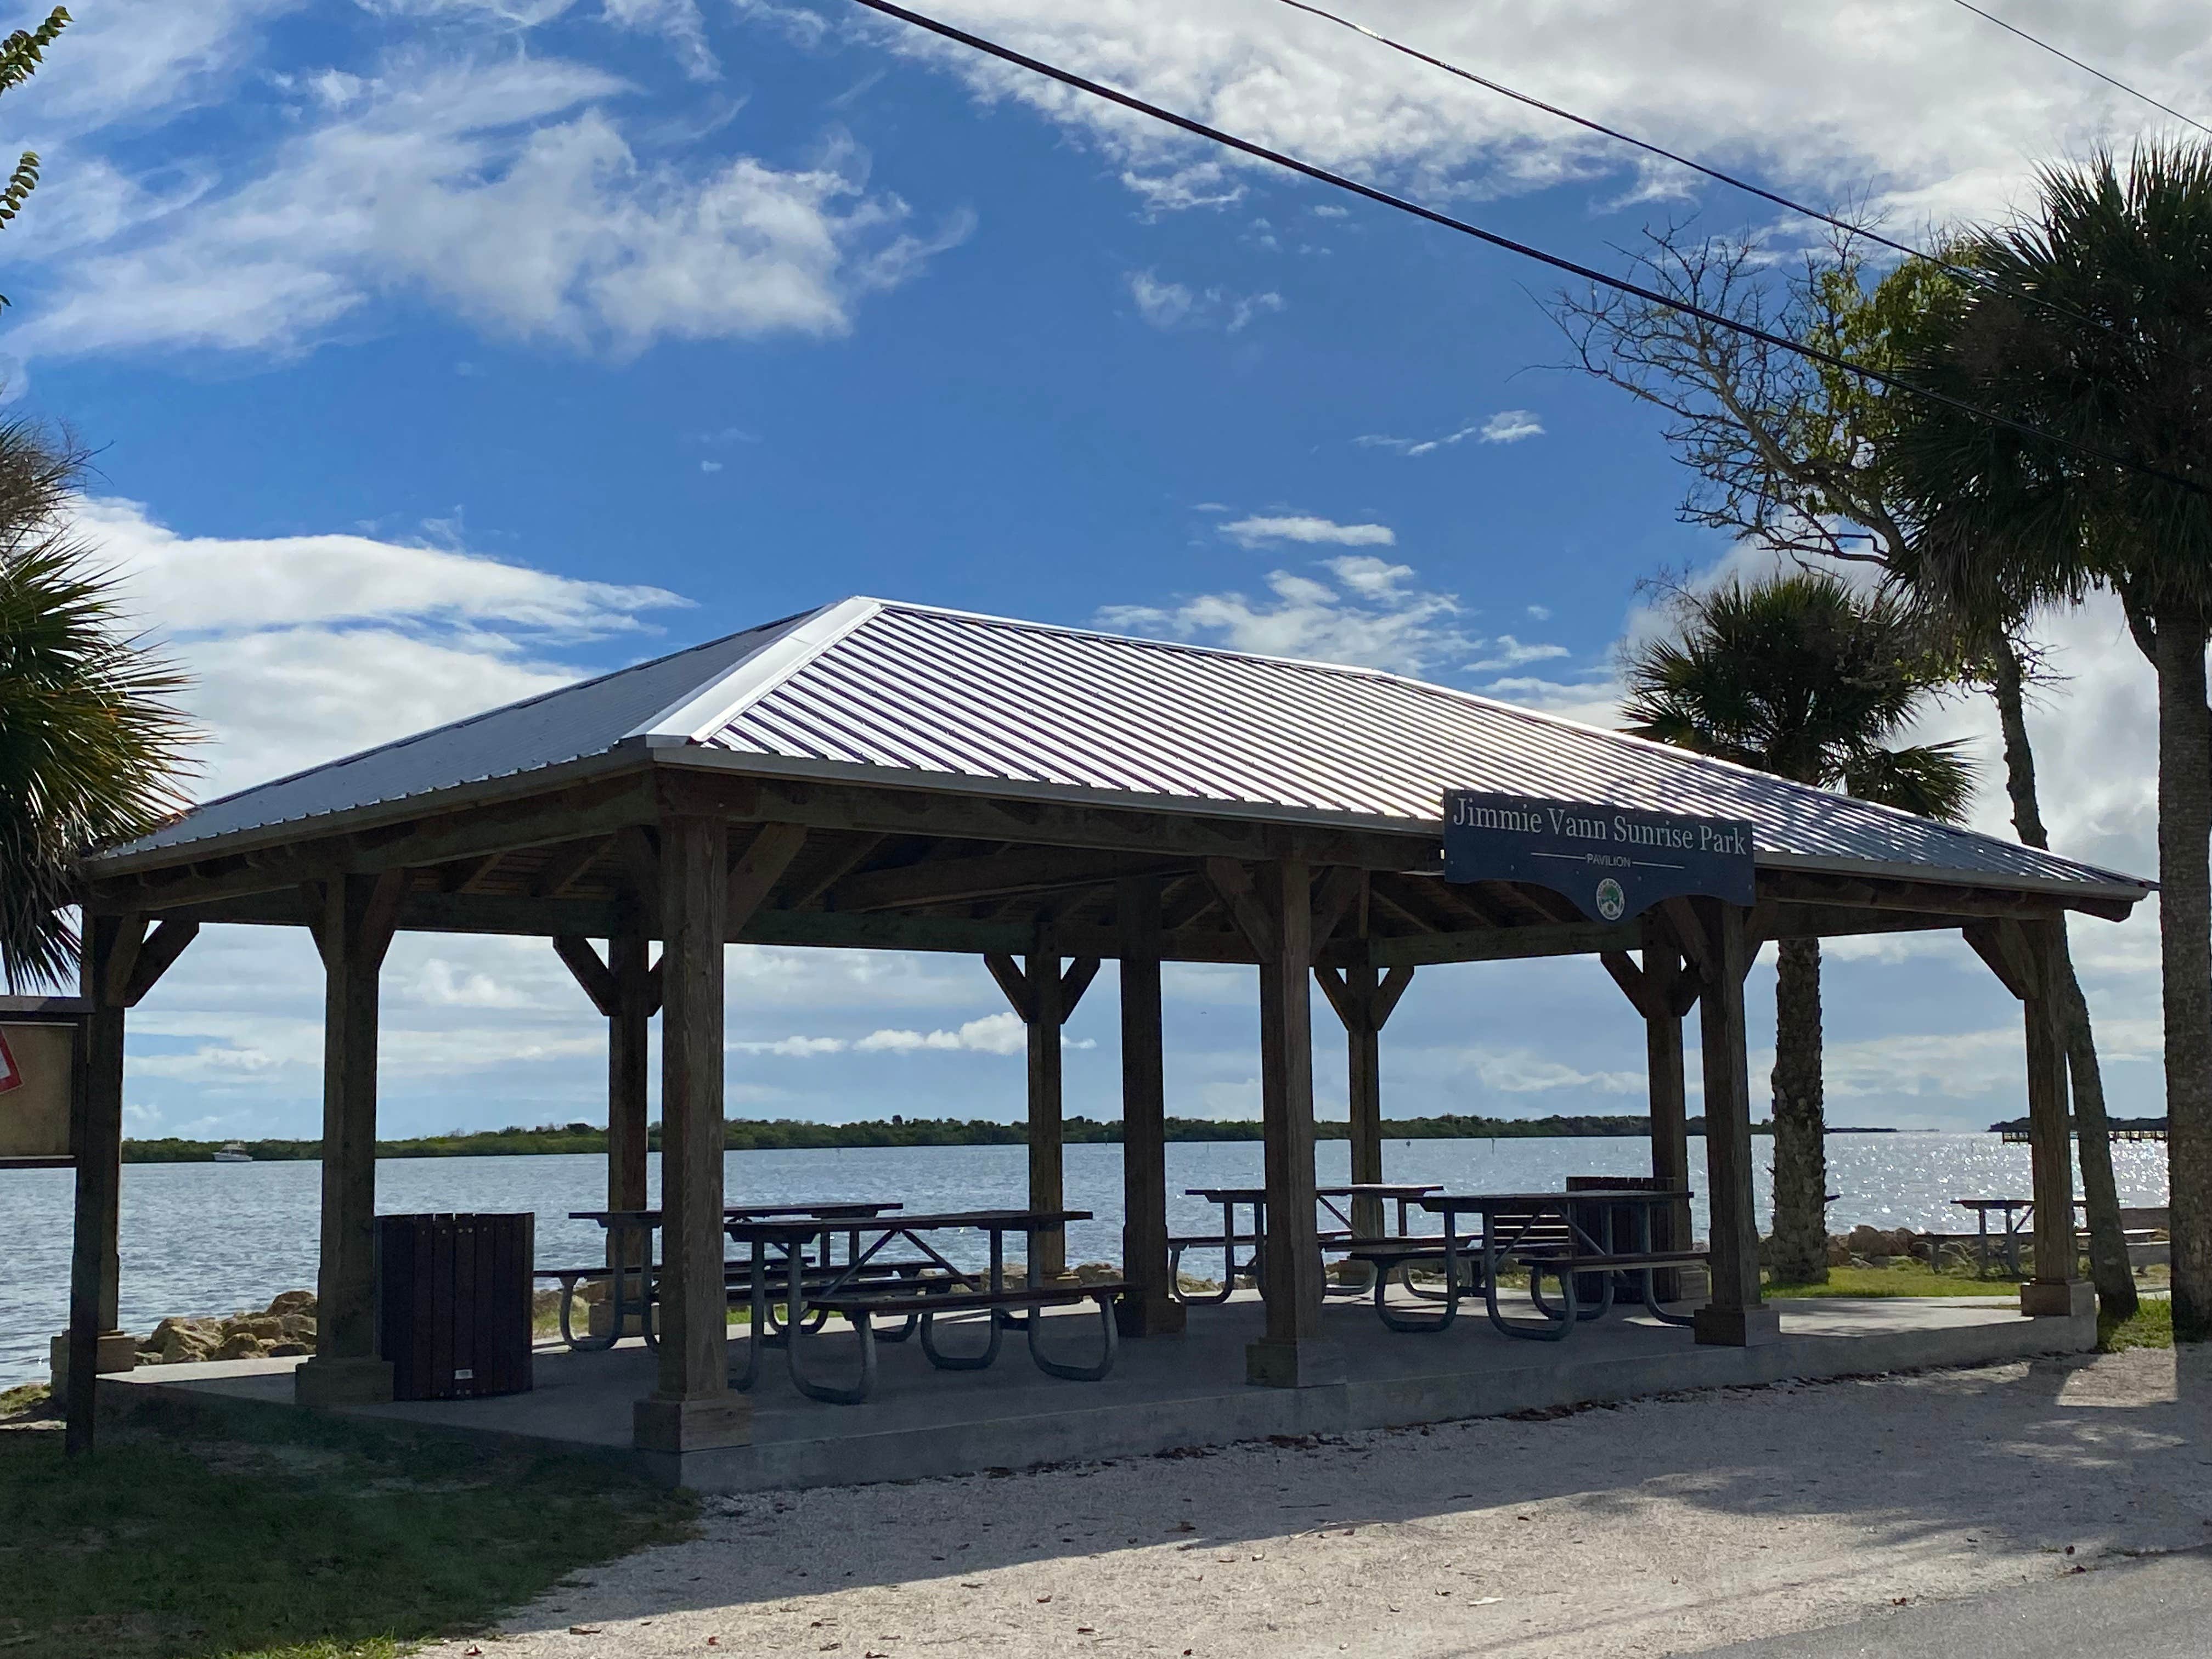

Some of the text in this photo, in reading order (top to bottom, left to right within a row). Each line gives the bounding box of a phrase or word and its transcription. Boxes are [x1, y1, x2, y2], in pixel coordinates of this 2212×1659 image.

[1453, 797, 1747, 855] Jimmie Vann Sunrise Park
[1585, 853, 1631, 867] PAVILION
